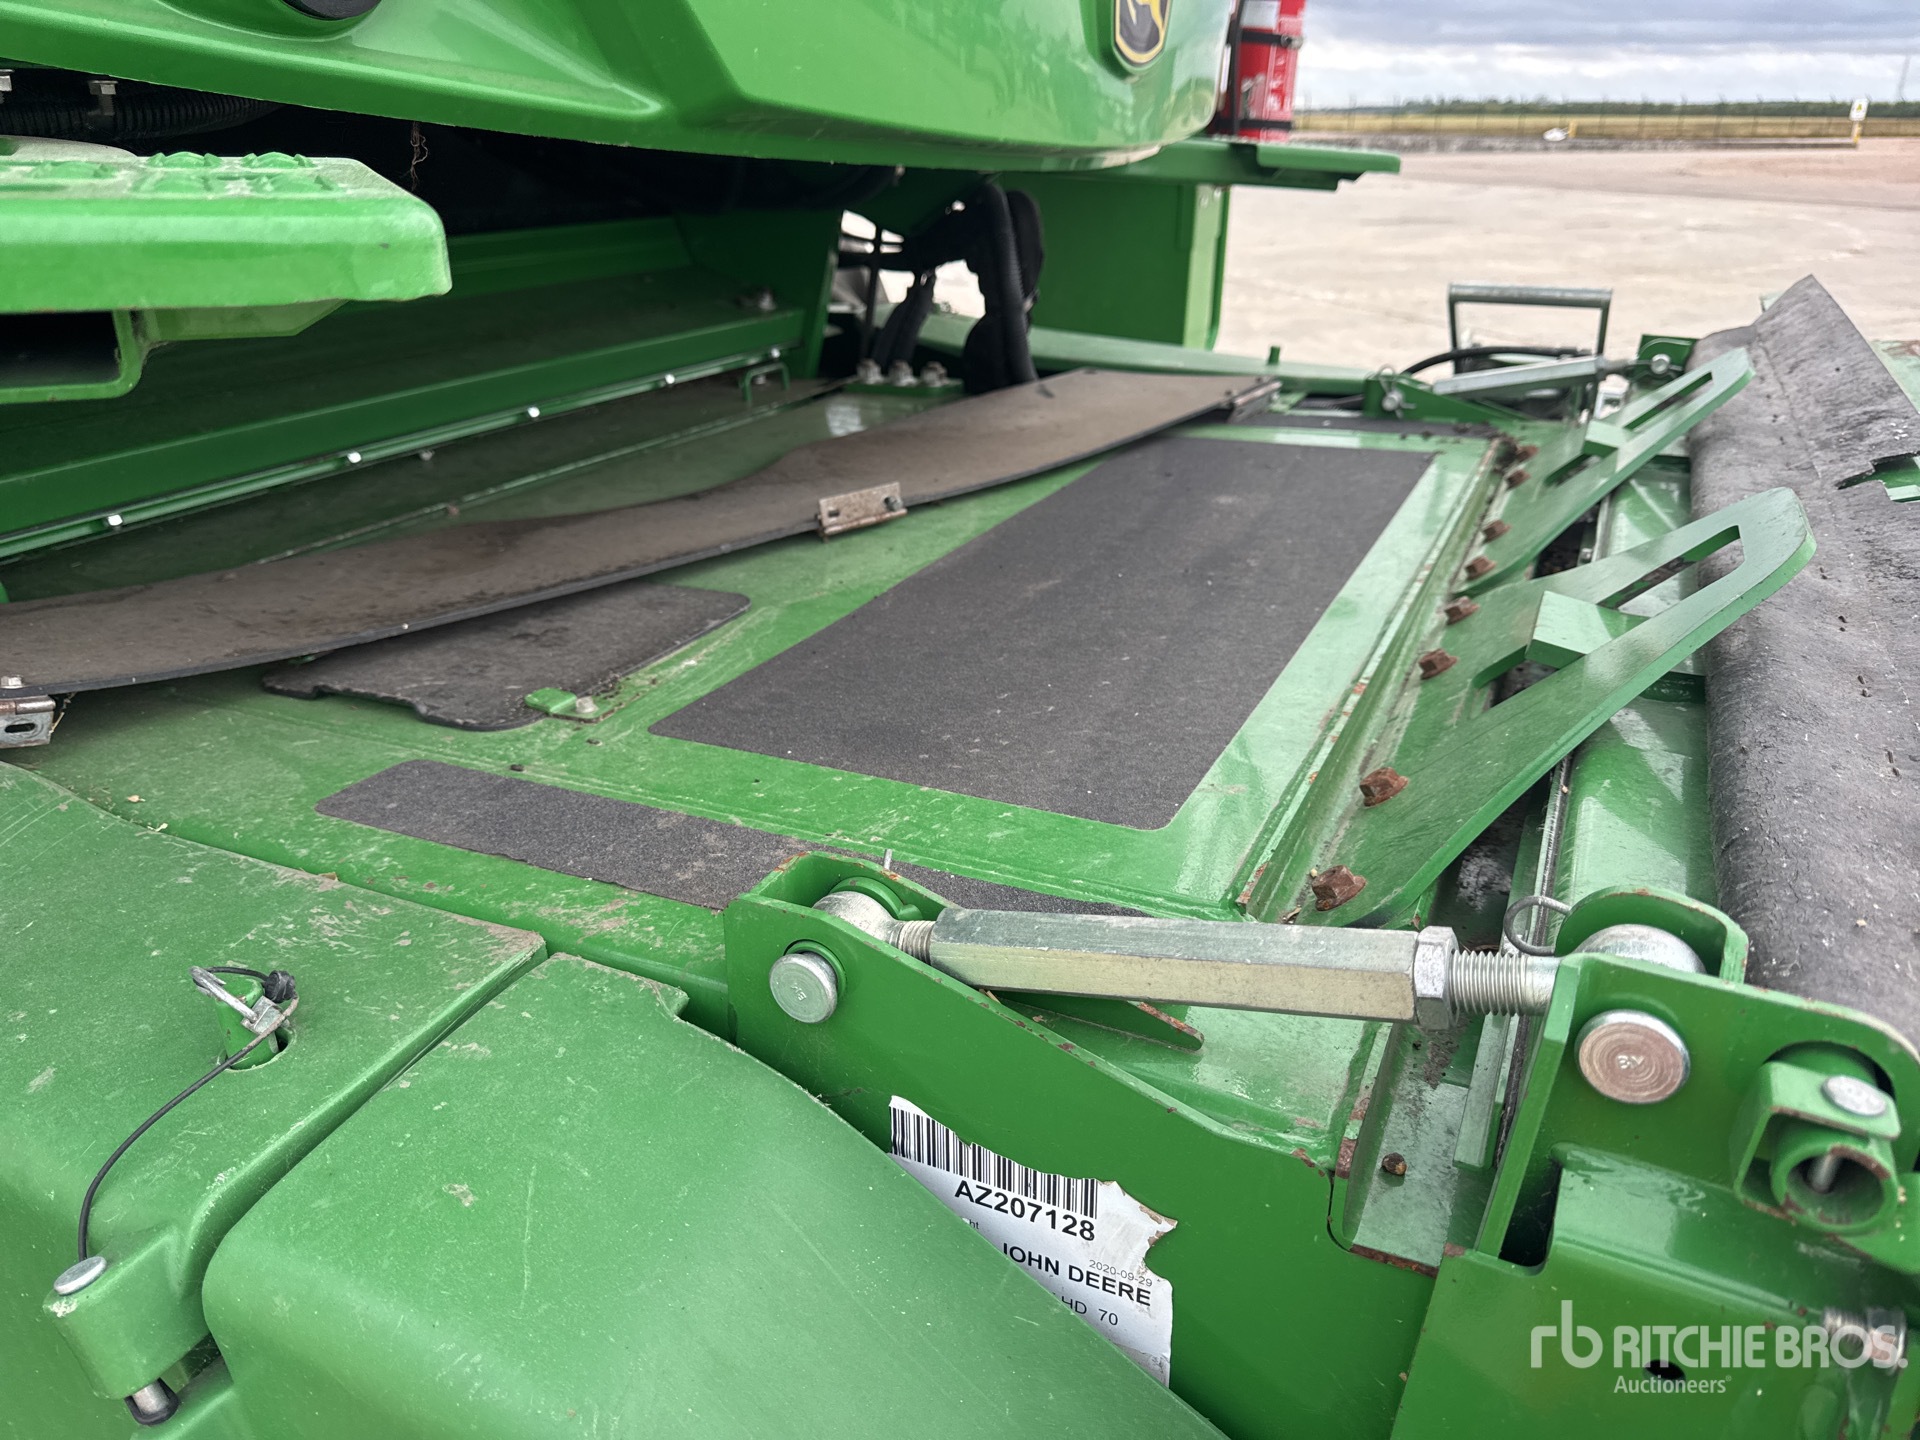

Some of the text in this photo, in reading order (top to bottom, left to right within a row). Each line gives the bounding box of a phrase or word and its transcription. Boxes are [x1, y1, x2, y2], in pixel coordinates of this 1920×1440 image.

[954, 1180, 1095, 1241] AZ207128
[1068, 1264, 1151, 1307] DEERE
[1089, 1260, 1152, 1287] 2020-09-29
[1098, 1308, 1119, 1326] 70
